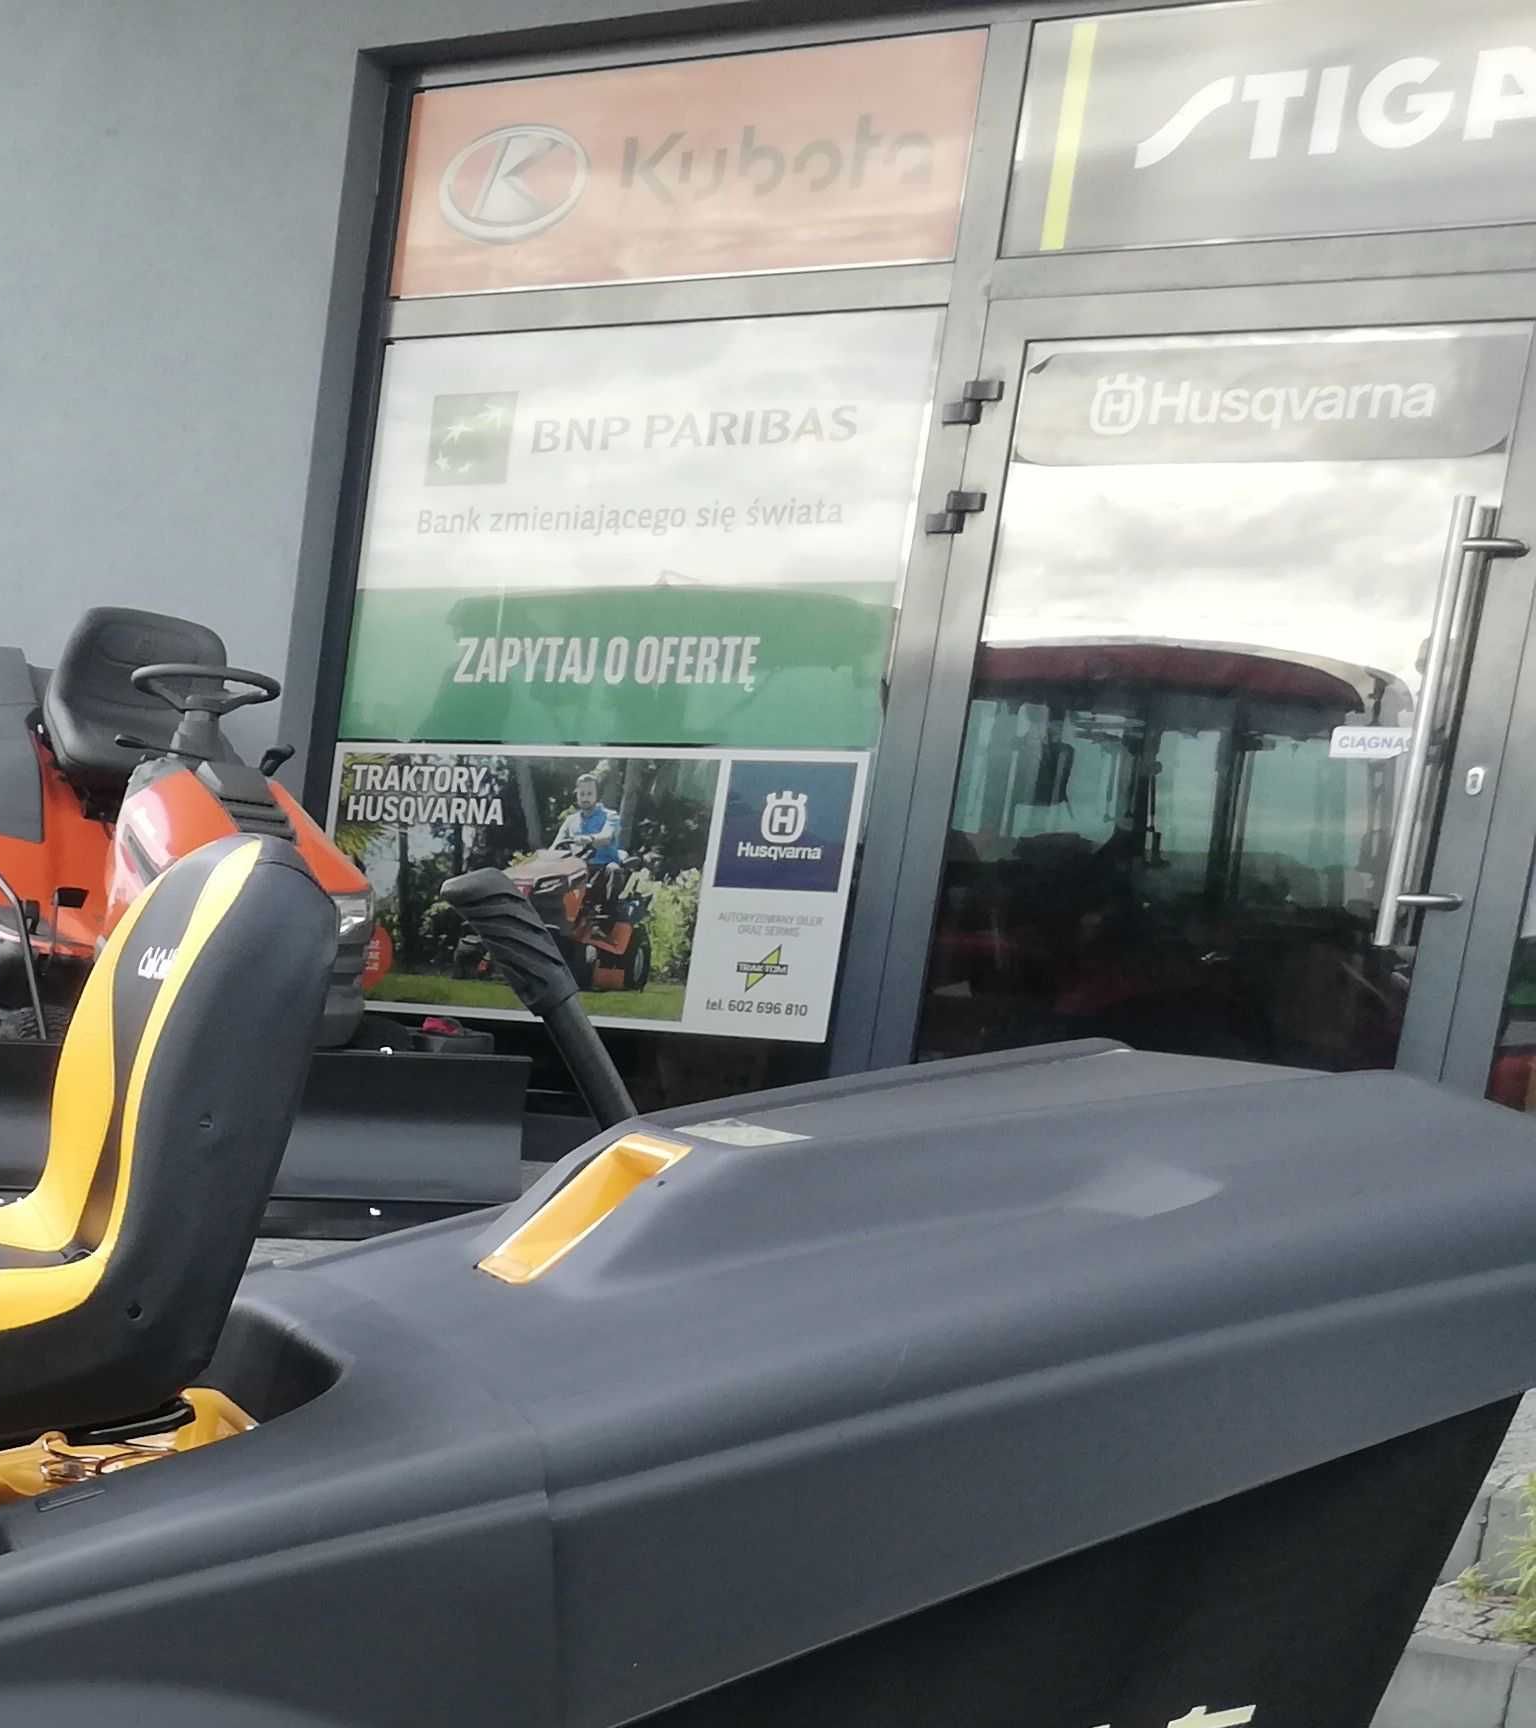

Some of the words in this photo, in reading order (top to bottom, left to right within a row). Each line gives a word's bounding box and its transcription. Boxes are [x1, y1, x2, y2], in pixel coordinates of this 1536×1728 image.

[1133, 45, 1536, 169] STIGA
[620, 112, 934, 206] Kubota
[1147, 380, 1437, 430] Husqvarna
[530, 415, 632, 454] BNP
[642, 404, 858, 450] PARIBAS
[417, 506, 480, 536] Bank
[488, 502, 687, 538] zmieniającego
[695, 502, 736, 532] się
[746, 496, 843, 528] świata
[453, 636, 600, 684] ZAPYTAJ
[603, 636, 630, 685] O
[634, 636, 761, 692] OFERTĘ
[351, 763, 488, 794] TRAKTORY
[346, 794, 505, 826] HUSQVARNA
[736, 841, 823, 861] Husqvarna
[727, 1000, 754, 1013] 602
[784, 1003, 808, 1017] 810
